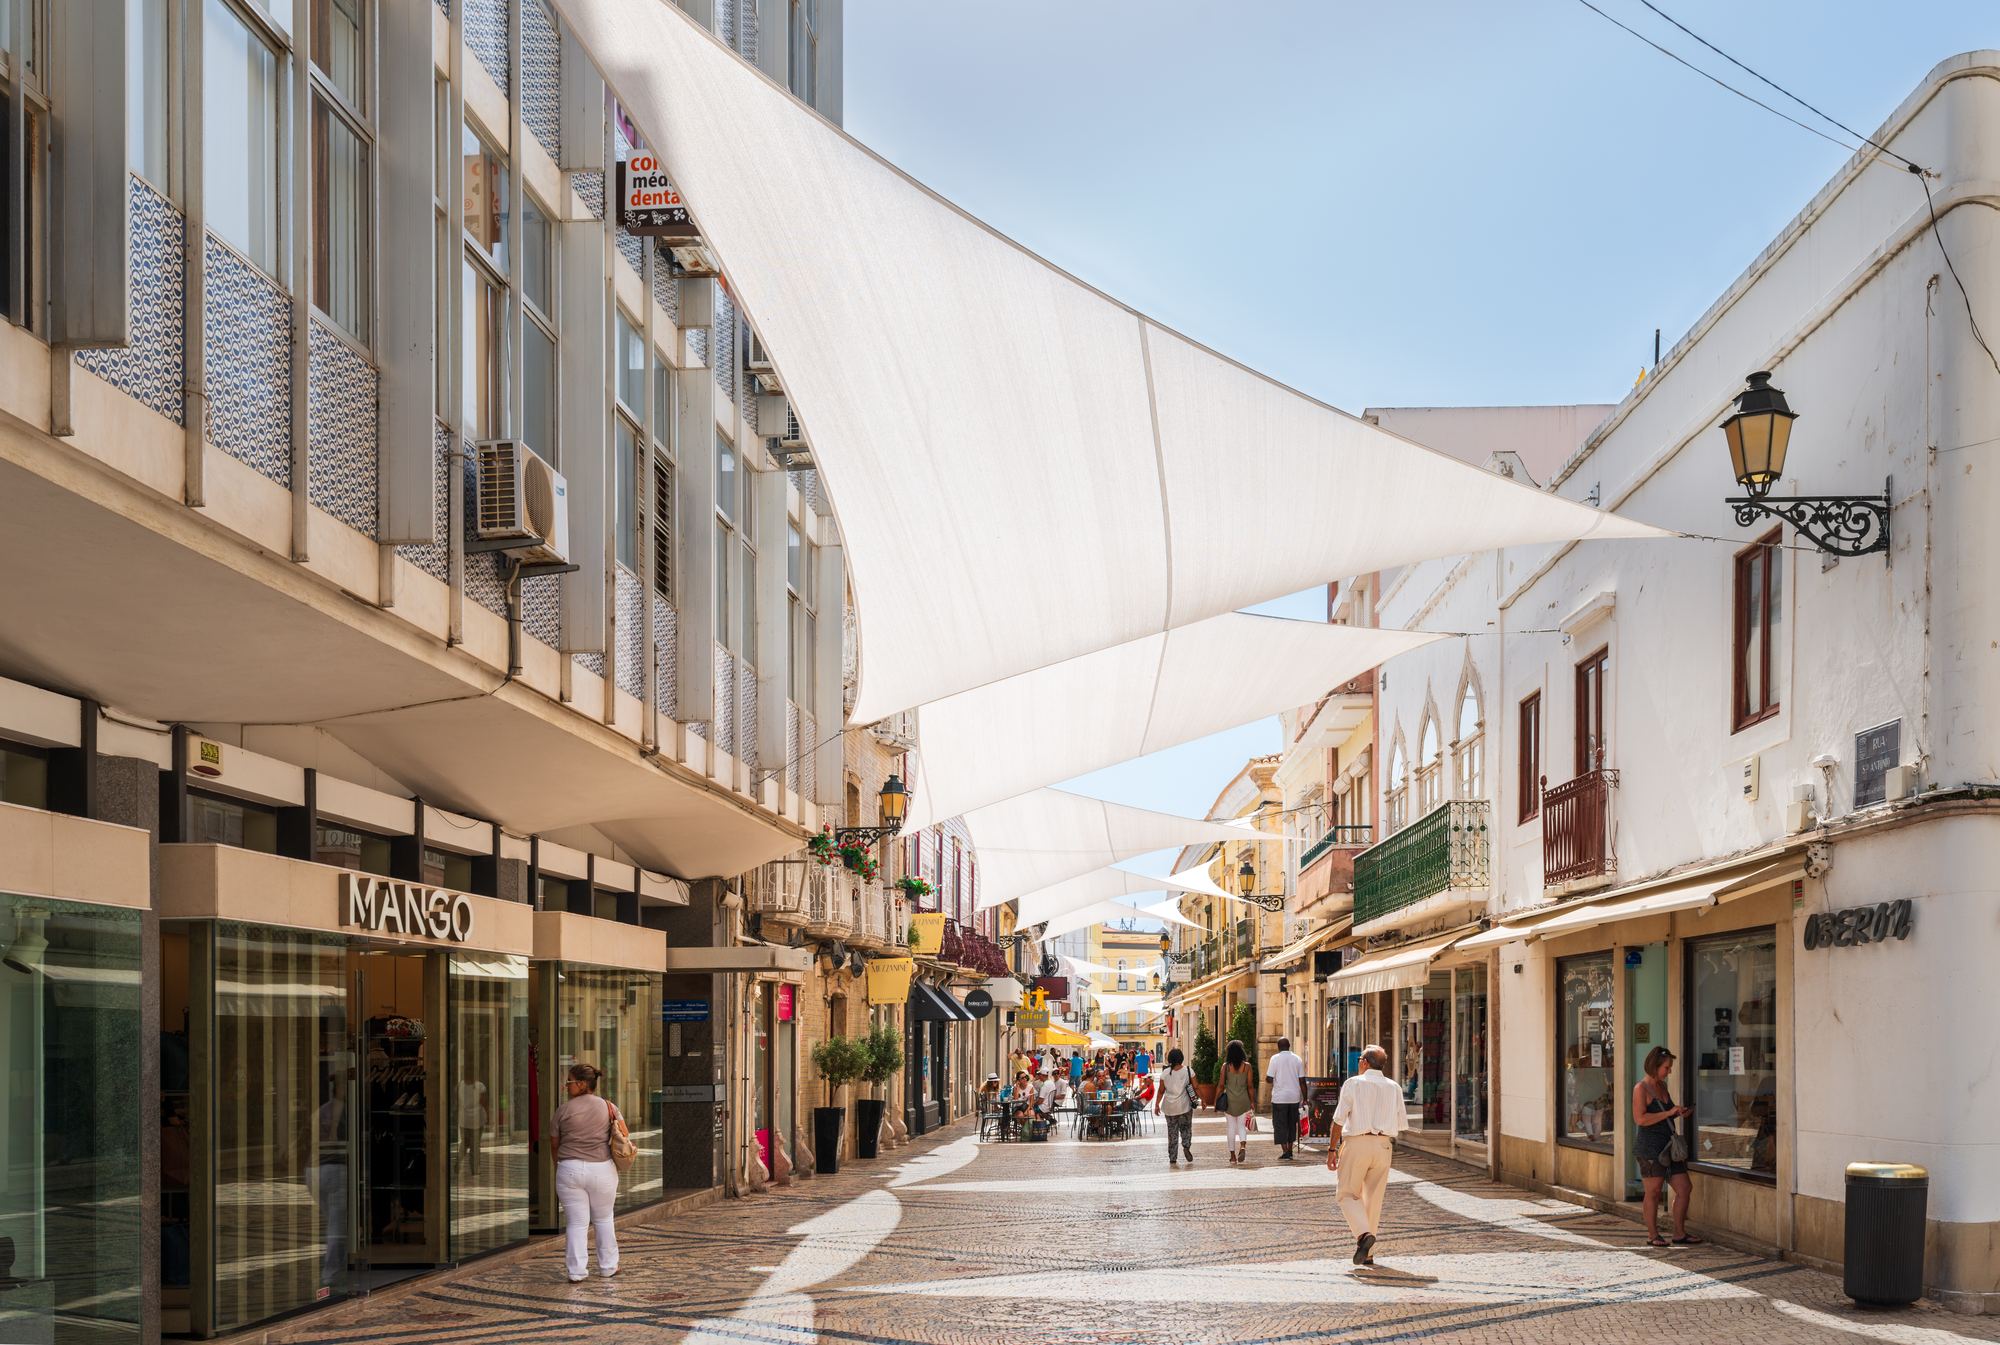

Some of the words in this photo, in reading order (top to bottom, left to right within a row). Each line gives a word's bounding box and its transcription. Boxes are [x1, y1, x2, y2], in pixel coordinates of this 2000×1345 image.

[630, 189, 681, 206] denta
[1872, 735, 1886, 751] RUA
[345, 872, 474, 942] MANGO
[871, 964, 906, 973] MEZZANINE
